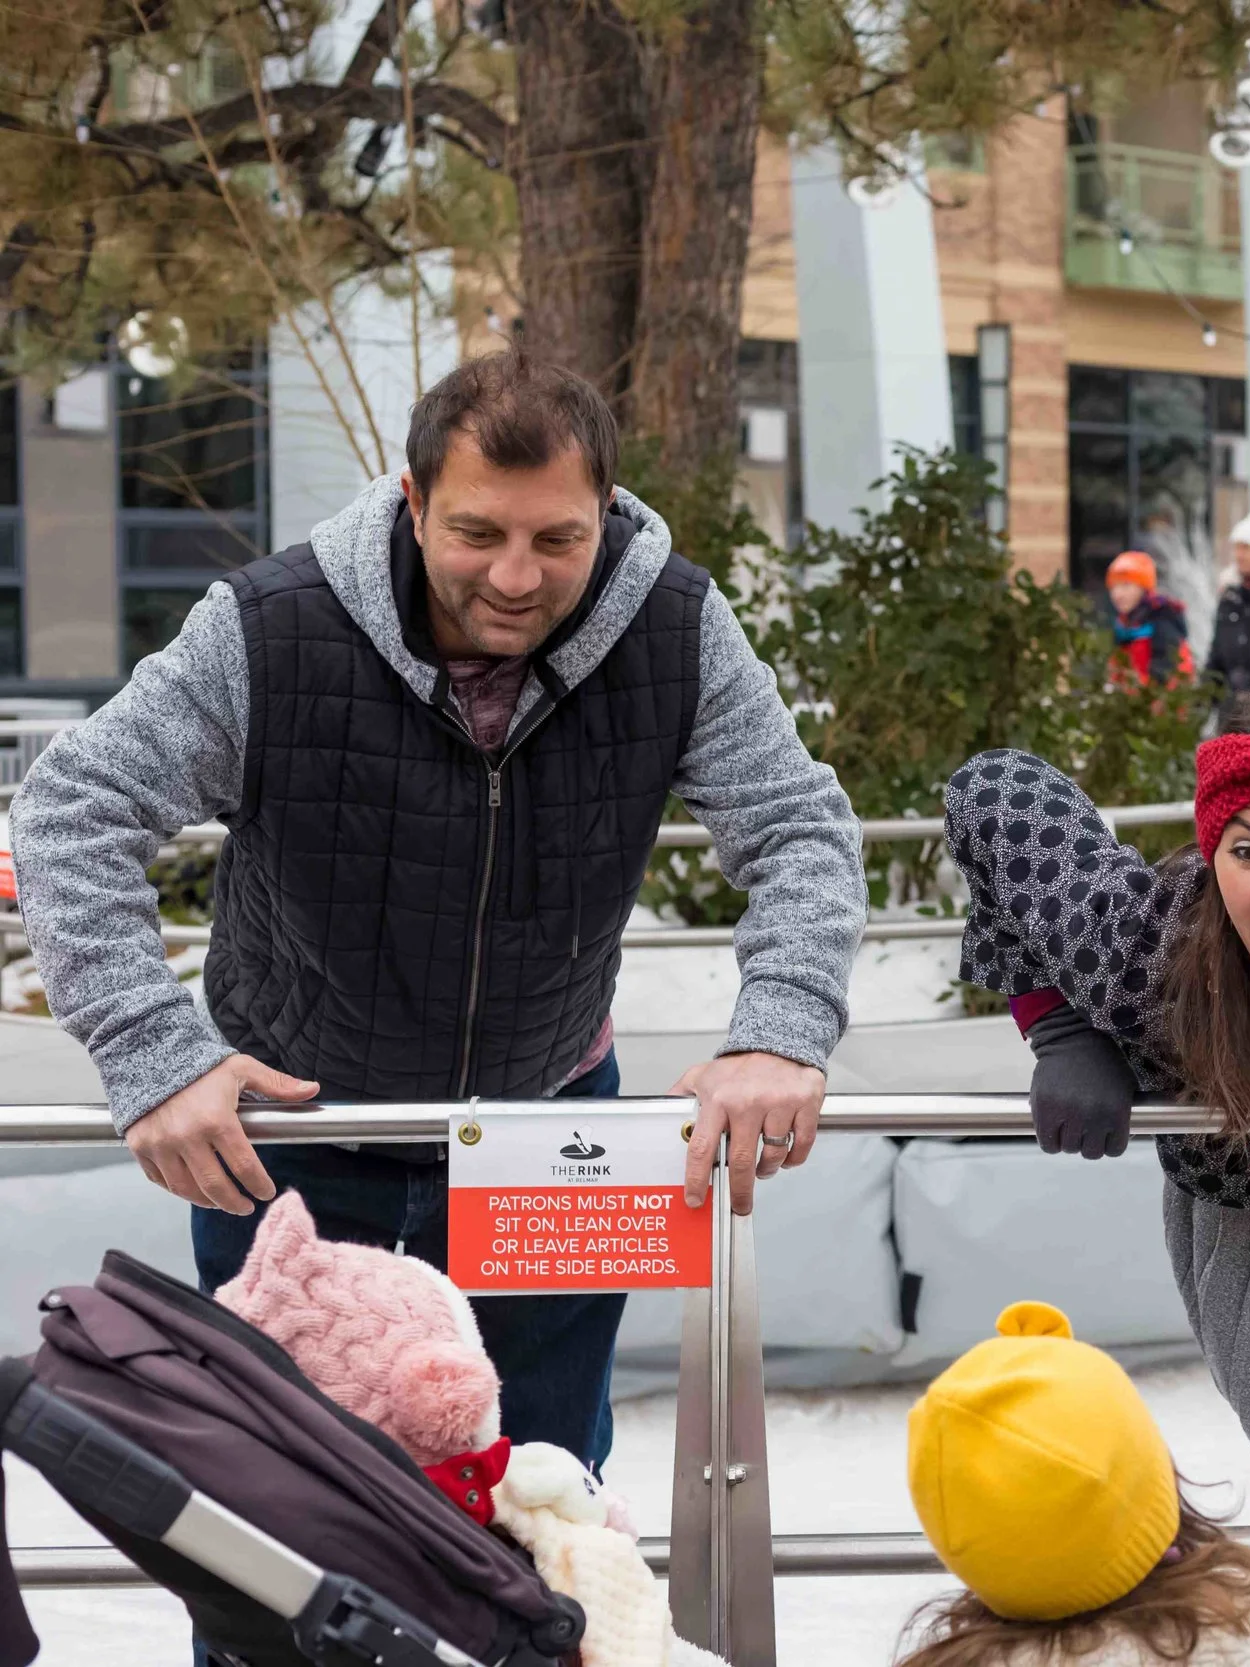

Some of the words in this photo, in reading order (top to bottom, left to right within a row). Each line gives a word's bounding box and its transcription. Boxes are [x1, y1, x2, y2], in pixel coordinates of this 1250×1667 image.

[489, 1196, 572, 1211] PATRONS
[578, 1195, 629, 1211] MUST
[634, 1195, 674, 1210] NOT
[495, 1217, 522, 1233] SIT
[527, 1217, 560, 1235] ON,
[565, 1217, 612, 1232] LEAN
[618, 1216, 667, 1232] OVER
[492, 1239, 519, 1255] OR
[524, 1238, 580, 1254] LEAVE
[585, 1238, 669, 1253] ARTICLES
[481, 1261, 509, 1276] ON
[515, 1260, 550, 1276] THE
[556, 1260, 596, 1275] SIDE
[602, 1259, 680, 1275] BOARDS.
